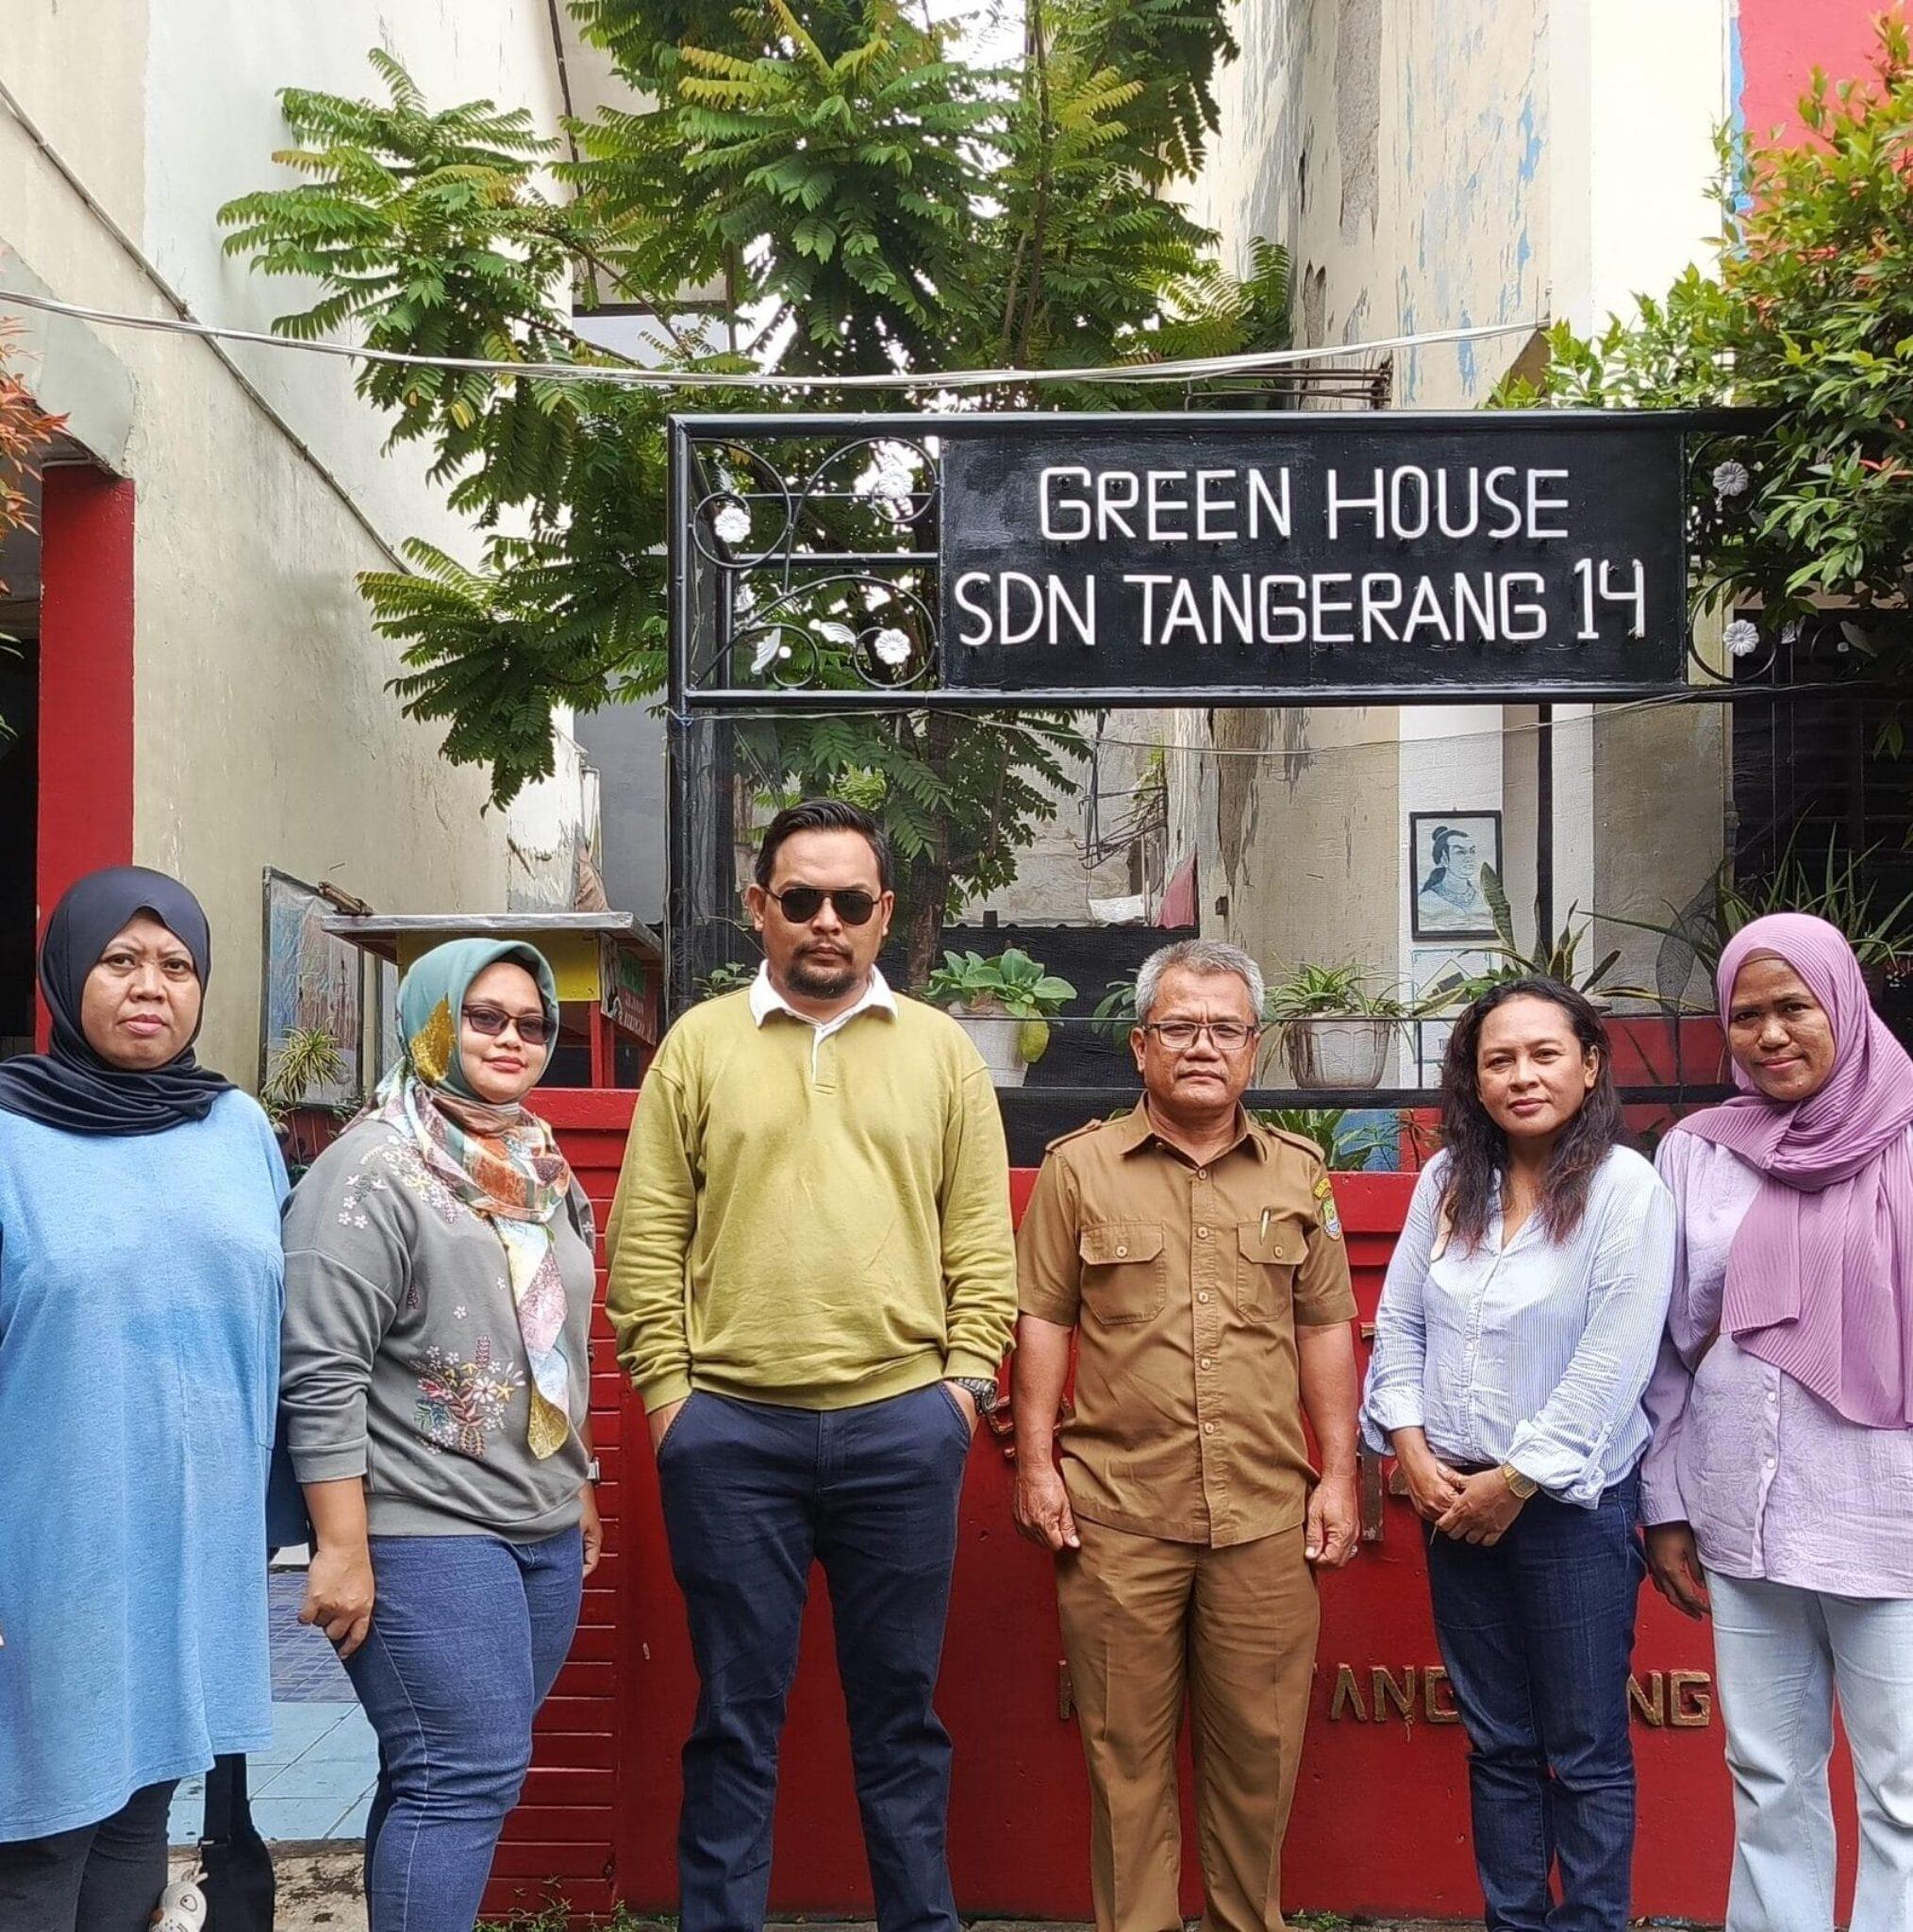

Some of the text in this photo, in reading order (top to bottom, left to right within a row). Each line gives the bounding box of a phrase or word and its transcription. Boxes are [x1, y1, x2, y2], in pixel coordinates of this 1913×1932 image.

[1040, 465, 1569, 542] GREEN HOUSE
[954, 558, 1646, 646] SDN TANGERANG 14
